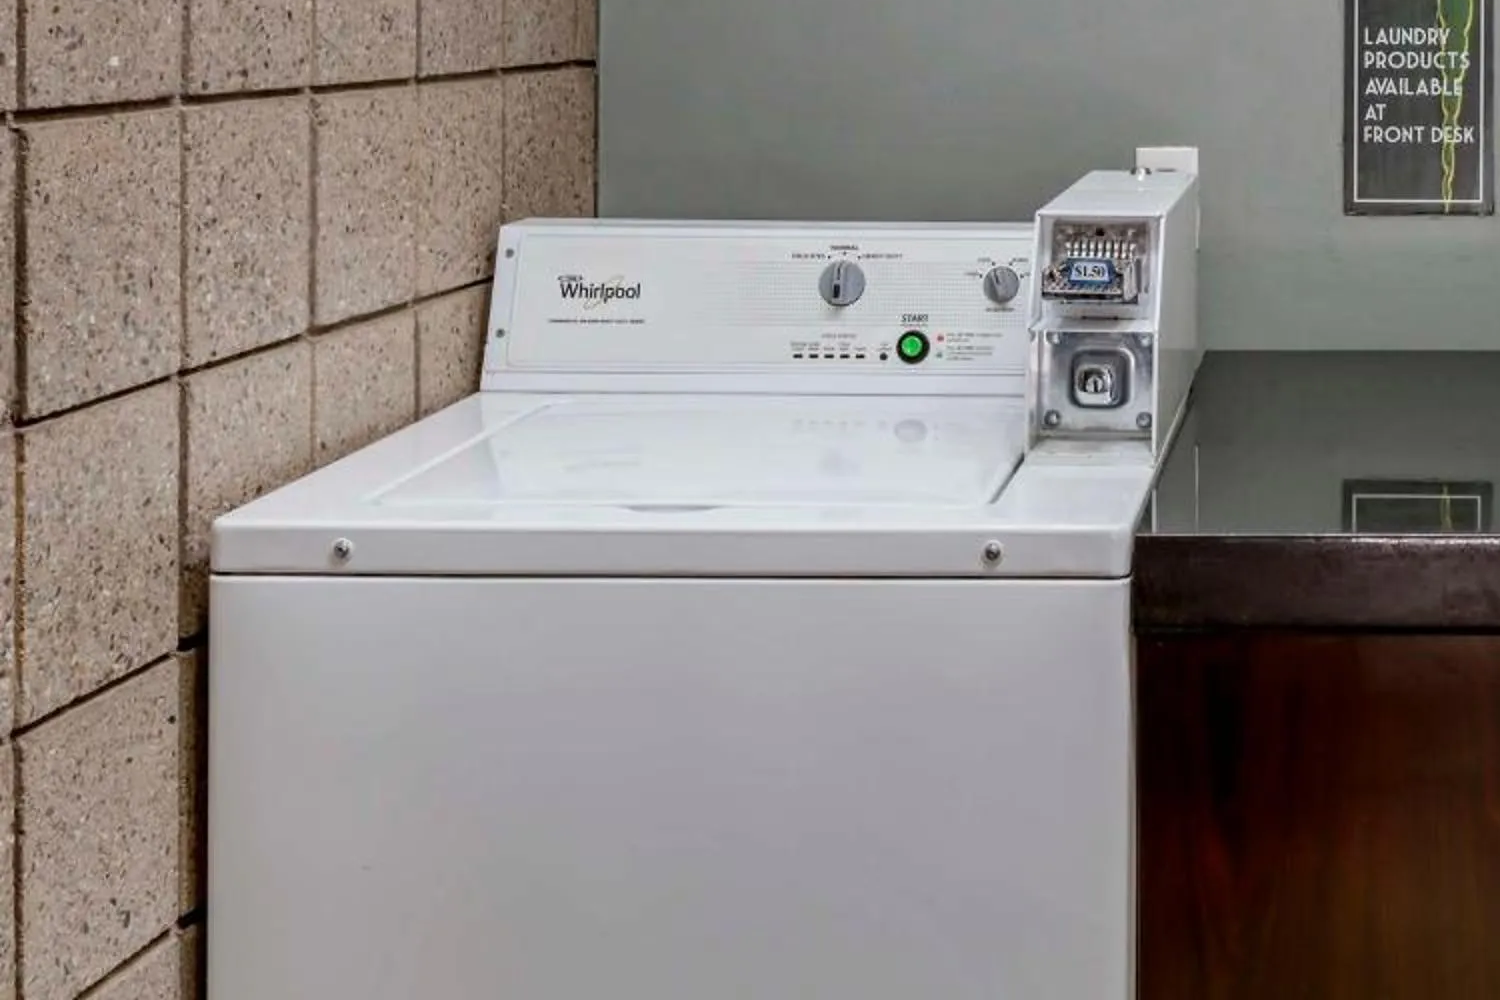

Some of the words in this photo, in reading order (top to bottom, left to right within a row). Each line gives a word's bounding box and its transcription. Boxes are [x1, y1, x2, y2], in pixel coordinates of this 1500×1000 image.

[1363, 27, 1450, 45] LAUNDRY
[1363, 51, 1471, 69] PRODUCTS
[1364, 77, 1463, 96] AVAILABLE
[1364, 103, 1387, 121] AT
[1363, 126, 1425, 143] FRONT
[1431, 126, 1475, 143] DESK
[560, 282, 641, 304] Whirlpool
[901, 313, 929, 322] START
